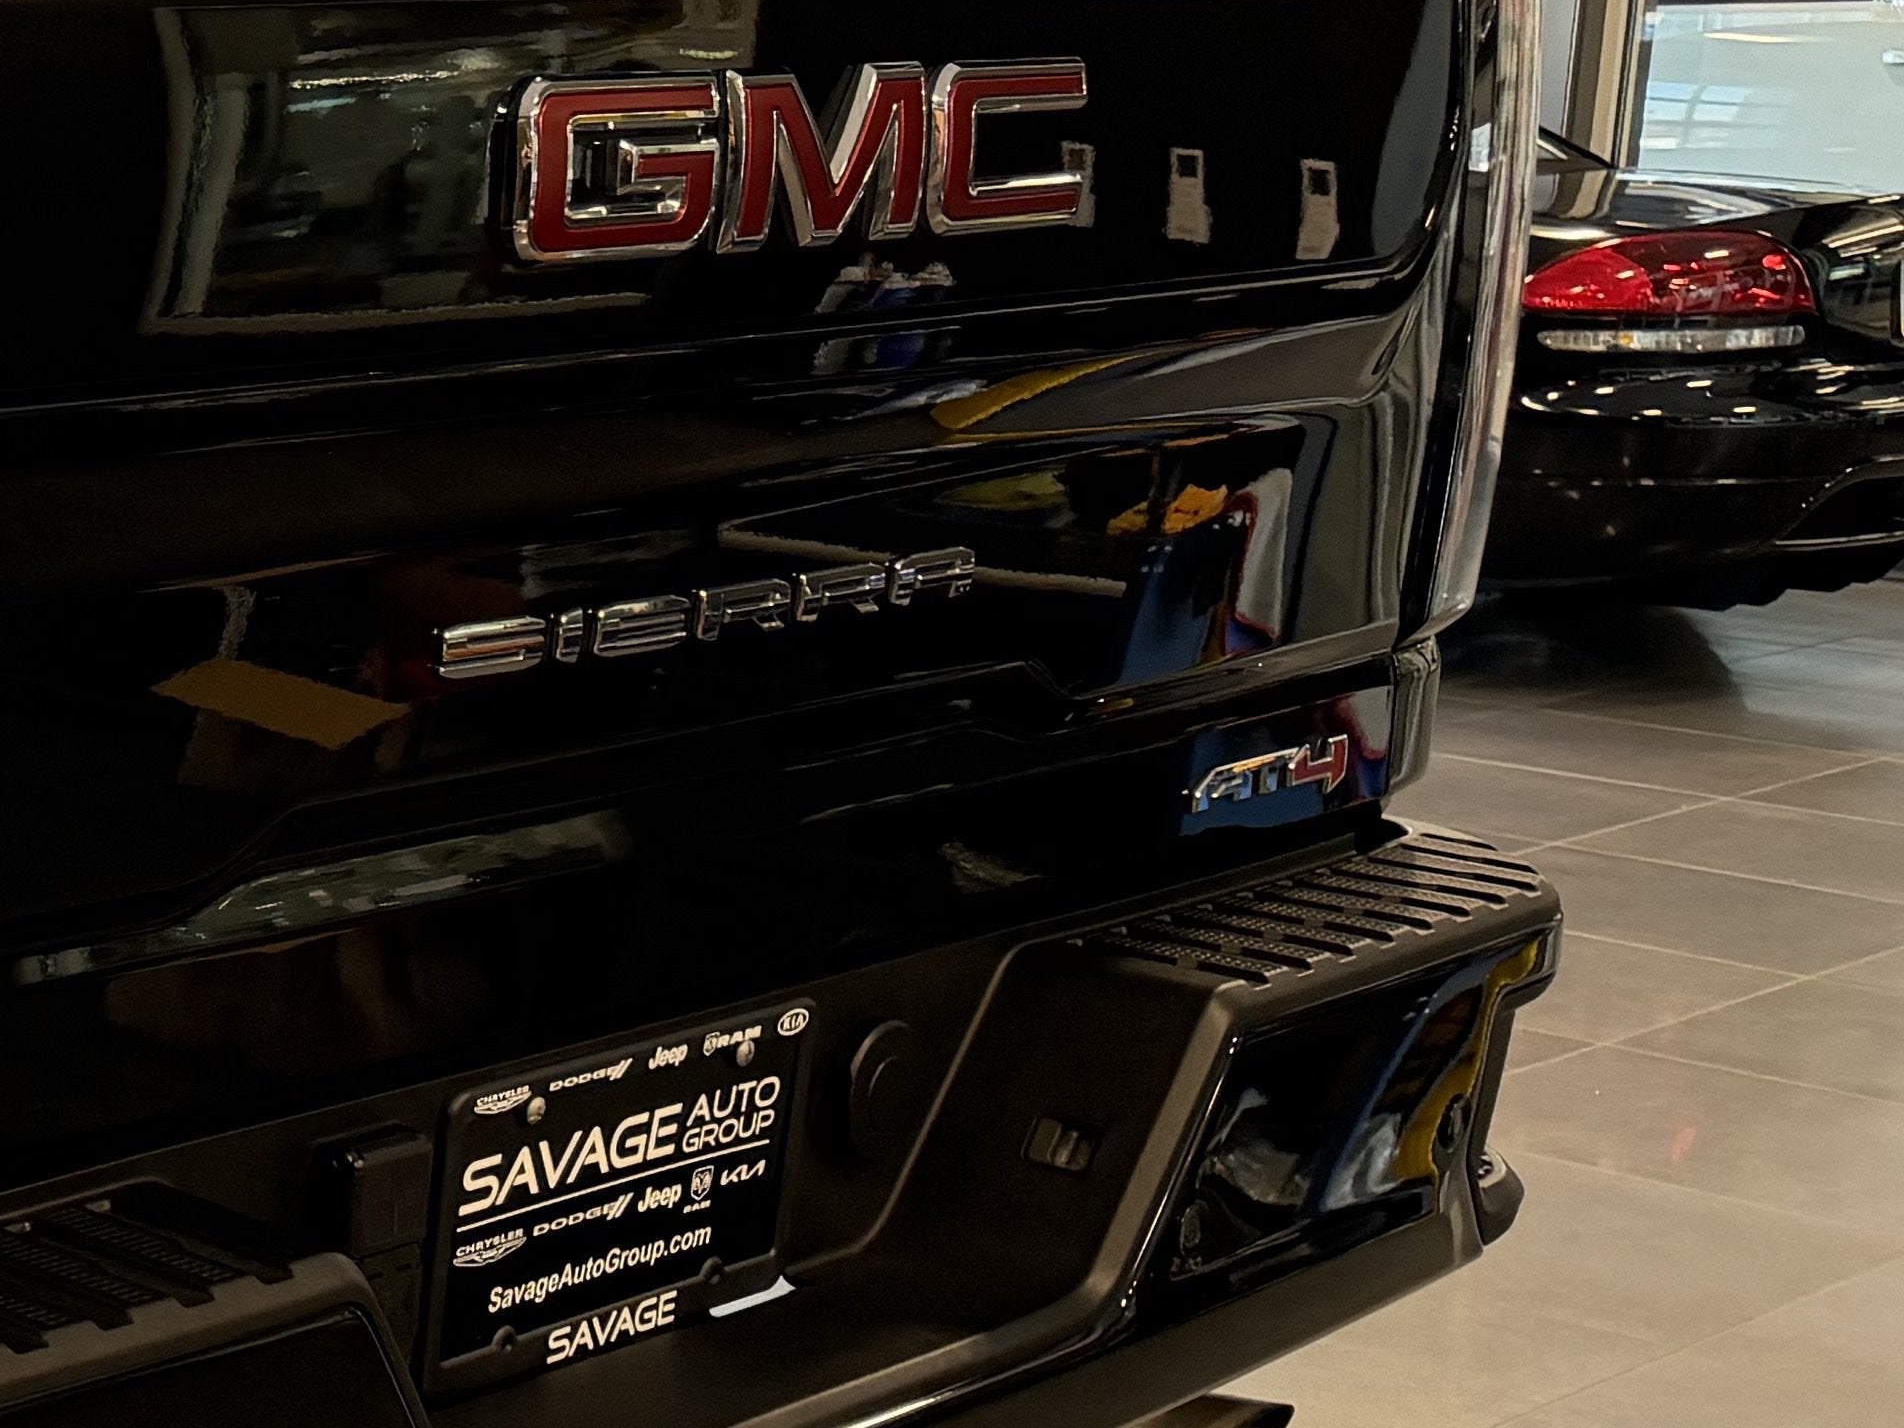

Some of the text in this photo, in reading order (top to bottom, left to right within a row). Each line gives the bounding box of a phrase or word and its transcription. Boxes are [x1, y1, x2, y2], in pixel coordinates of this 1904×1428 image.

[507, 56, 1088, 262] GMC
[439, 546, 975, 679] SIERRA
[1192, 734, 1348, 813] AT4
[476, 1085, 529, 1106] CHRYSLER
[549, 1062, 621, 1092] DODGE
[648, 1044, 688, 1069] Jeep
[716, 1025, 762, 1048] RAM
[458, 1076, 780, 1216] SAVAGE AUTO
[682, 1109, 775, 1153] GROUP
[456, 1228, 524, 1256] CHRYSLER
[533, 1202, 617, 1236] DODGE
[638, 1184, 682, 1212] Jeep
[488, 1226, 712, 1313] SavageAutoGroup.com
[546, 1290, 677, 1364] SAVAGE
